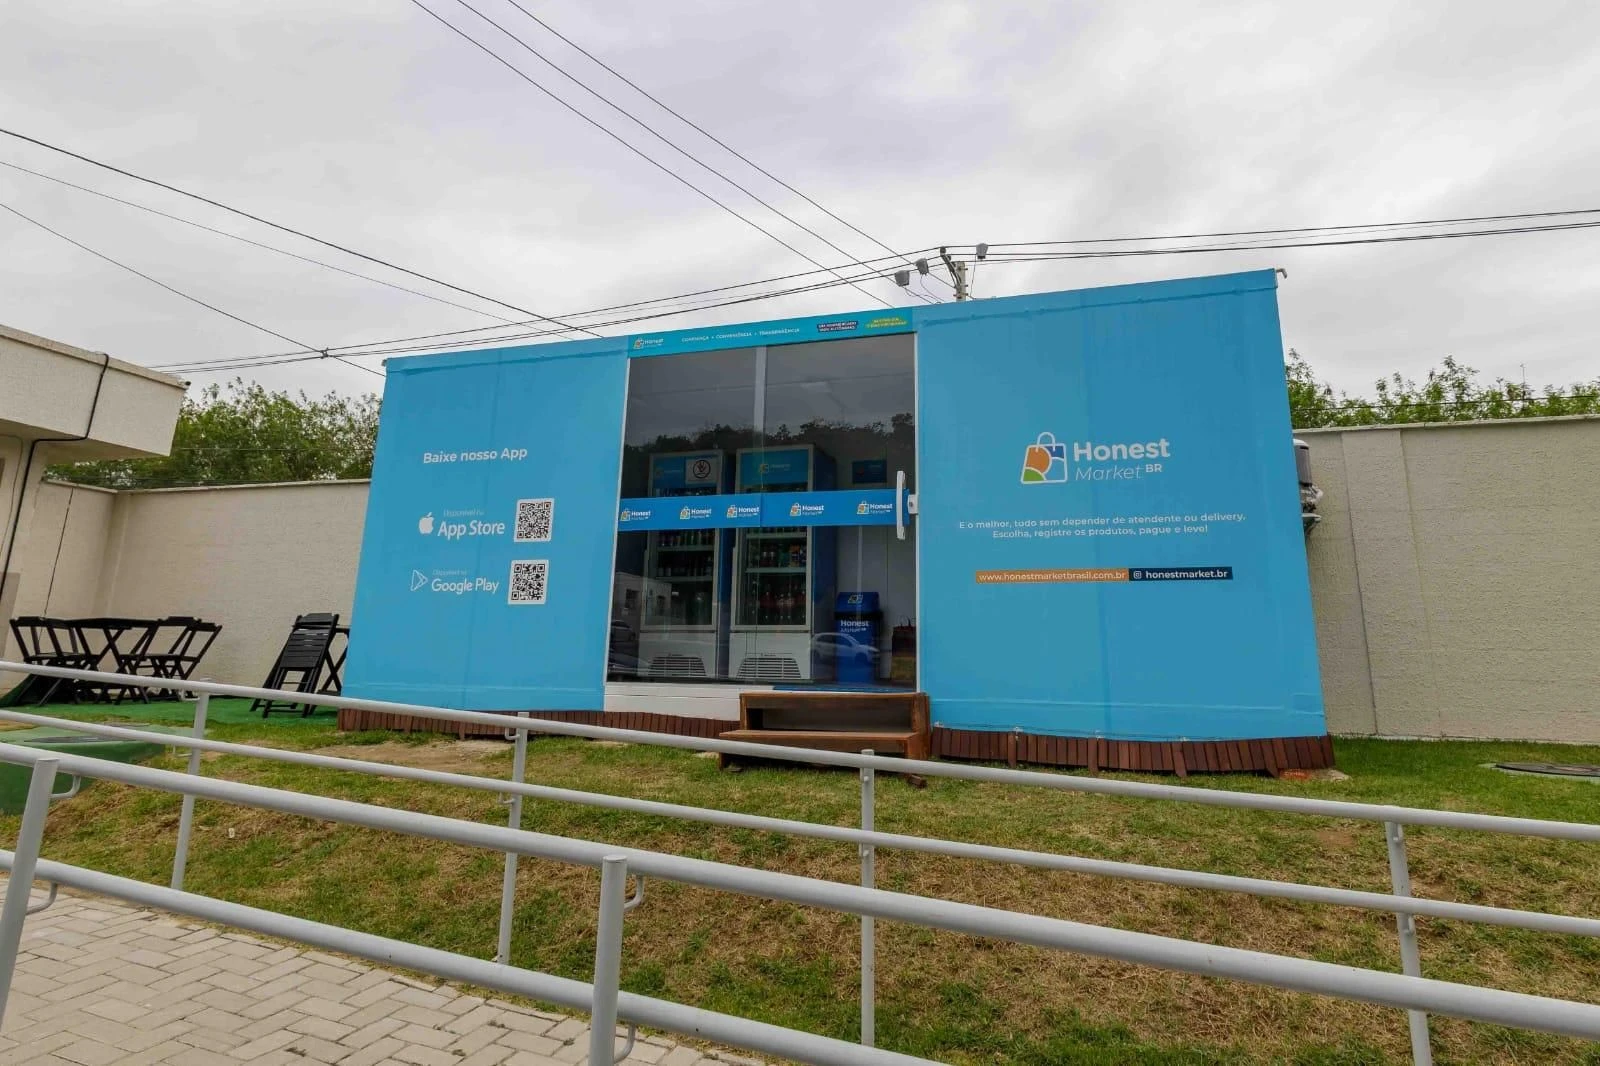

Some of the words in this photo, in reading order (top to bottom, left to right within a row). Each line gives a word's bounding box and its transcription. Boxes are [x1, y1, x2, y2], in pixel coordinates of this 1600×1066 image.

[423, 451, 457, 464] Baixe
[460, 450, 498, 462] nosso
[500, 447, 528, 461] App
[1073, 438, 1171, 462] Honest
[1075, 465, 1144, 481] Market
[1145, 463, 1163, 473] BR
[975, 518, 1013, 528] melhor,
[1039, 519, 1060, 527] sem
[1062, 516, 1109, 527] depender
[1112, 516, 1126, 525] de
[1128, 514, 1181, 524] atendente
[1200, 512, 1246, 522] delivery.
[437, 520, 467, 540] App
[468, 519, 506, 536] Store
[992, 529, 1032, 539] Escolha,
[1034, 528, 1072, 538] registre
[1088, 527, 1137, 537] produtos,
[1139, 526, 1172, 535] pague
[978, 571, 1126, 581] www.honestmarketbrasil.com.br
[1145, 569, 1228, 579] honestmarket.br
[431, 577, 473, 595] Google
[475, 577, 500, 595] Play
